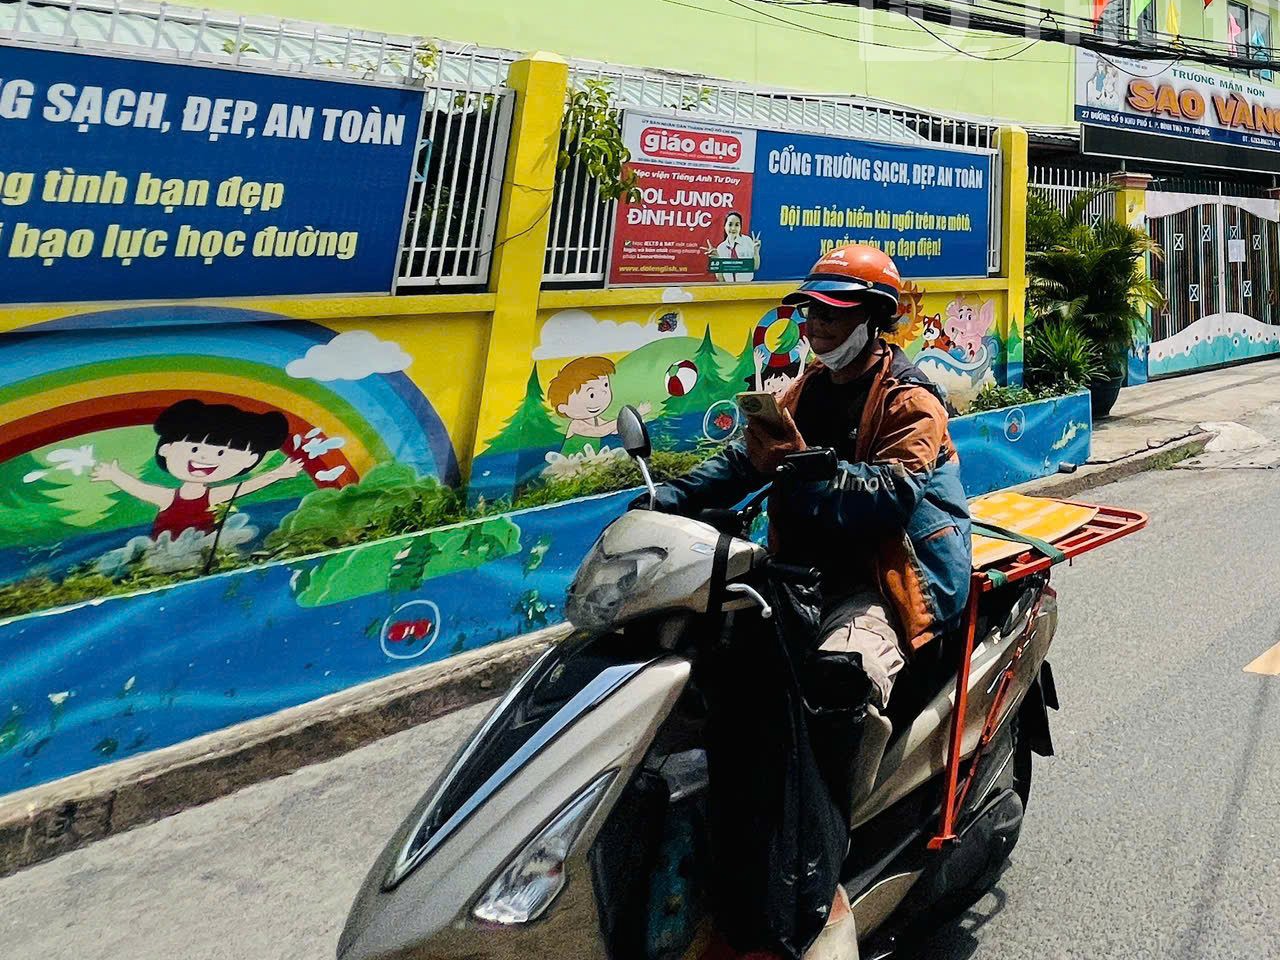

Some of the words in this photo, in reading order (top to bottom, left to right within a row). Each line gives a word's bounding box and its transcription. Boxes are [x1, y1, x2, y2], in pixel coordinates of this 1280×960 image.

[1127, 78, 1206, 120] SAO
[1247, 86, 1265, 98] NON
[0, 78, 35, 120] G
[43, 82, 171, 133] SẠCH,
[181, 94, 257, 141] ĐẸP,
[262, 103, 315, 140] AN
[322, 105, 406, 146] TOÀN
[1082, 110, 1089, 118] 27
[643, 130, 696, 153] giáo
[700, 137, 738, 160] dục
[651, 170, 669, 179] viện
[672, 172, 694, 182] Tiếng
[714, 175, 724, 183] Tư
[725, 177, 741, 185] Duy
[768, 145, 812, 176] CỔNG
[814, 152, 871, 181] TRƯỜNG
[873, 159, 910, 187] SẠCH,
[912, 164, 936, 190] ĐẸP,
[937, 166, 953, 187] AN
[955, 165, 983, 189] TOÀN
[0, 171, 35, 206] g
[42, 167, 128, 204] tình
[134, 173, 209, 213] bạn
[216, 176, 285, 215] đẹp
[670, 190, 734, 208] JUNIOR
[627, 204, 674, 226] ĐÌNH
[676, 209, 712, 231] LỰC
[780, 204, 801, 231] Đội
[802, 205, 821, 227] mũ
[823, 204, 844, 227] bảo
[845, 205, 873, 229] hiểm
[874, 209, 891, 229] khi
[915, 211, 935, 230] trên
[936, 214, 947, 231] xe
[8, 222, 95, 266] bạo
[101, 224, 168, 266] lực
[175, 224, 247, 265] học
[252, 225, 358, 260] đường
[884, 240, 896, 257] xe
[897, 238, 916, 261] đạp
[917, 237, 942, 260] điện!
